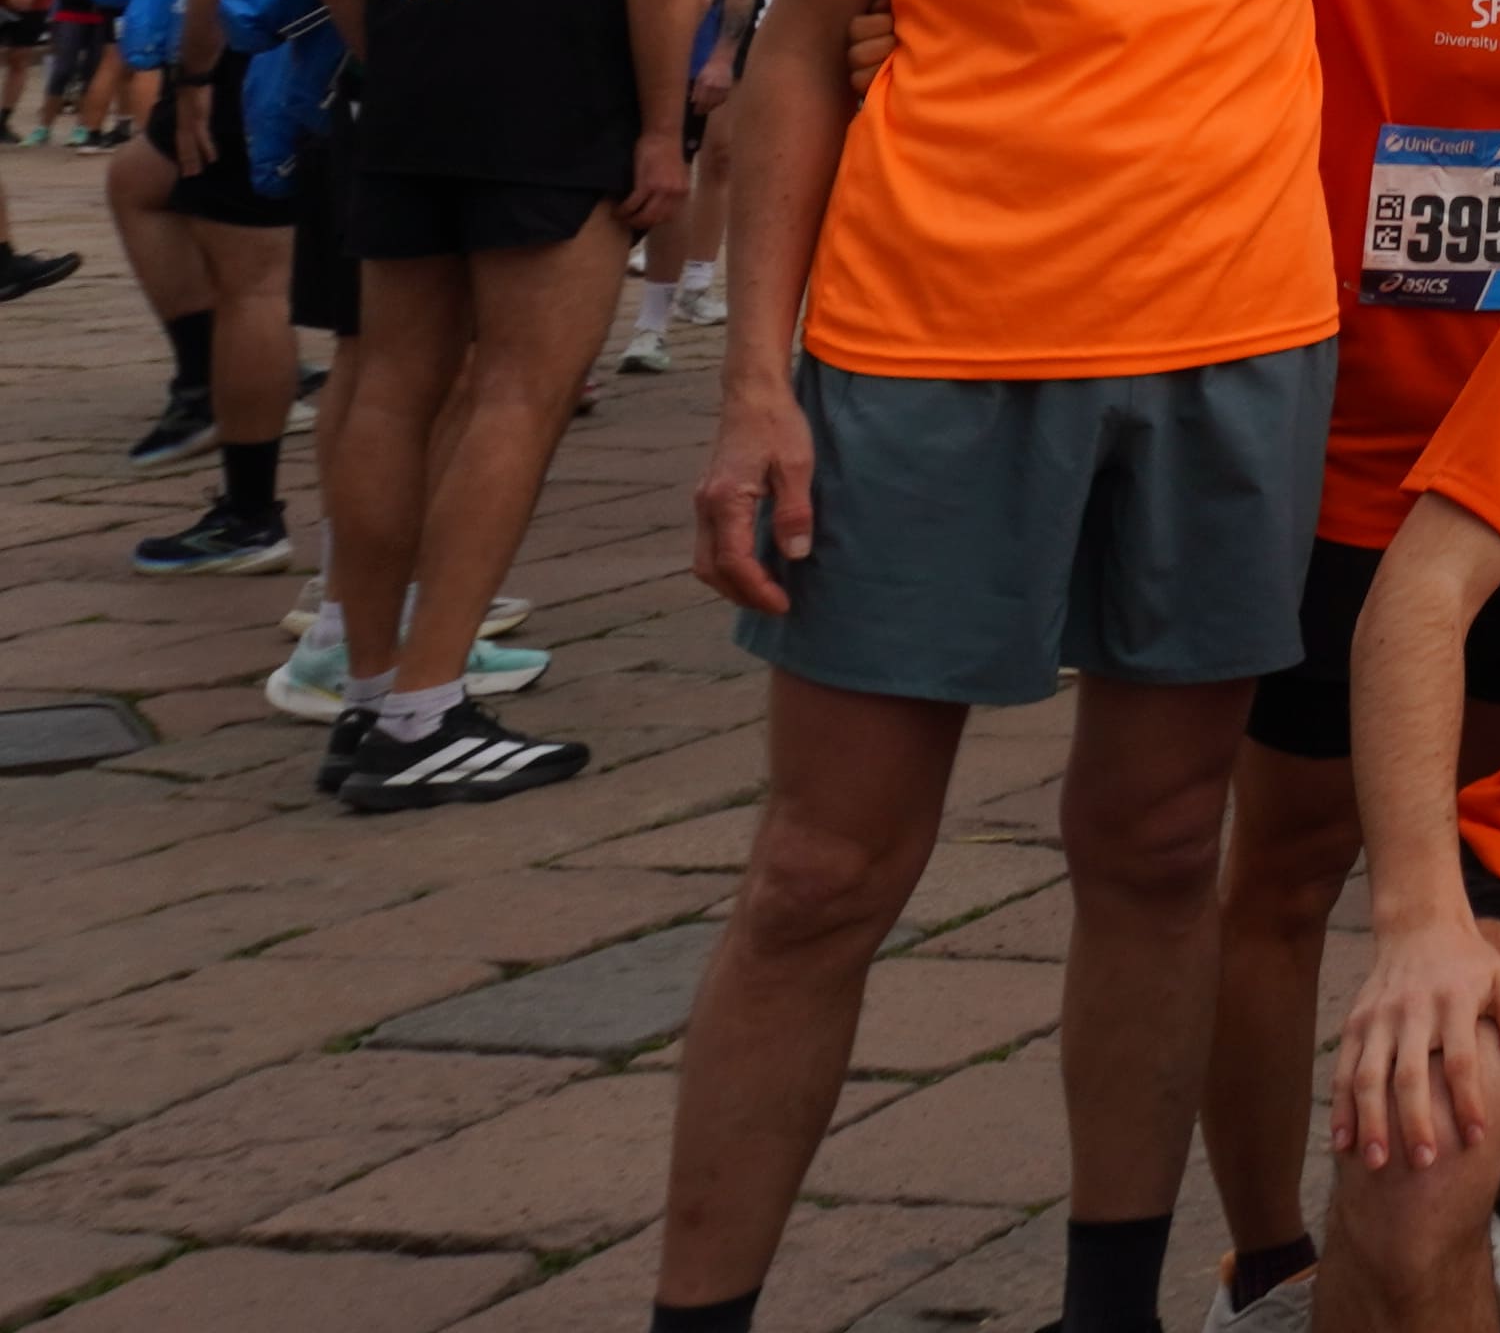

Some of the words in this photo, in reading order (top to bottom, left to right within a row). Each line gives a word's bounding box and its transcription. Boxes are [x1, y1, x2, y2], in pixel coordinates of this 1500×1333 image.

[1434, 30, 1499, 52] Diversity
[1404, 136, 1477, 155] UniCredit
[1402, 276, 1449, 294] asics
